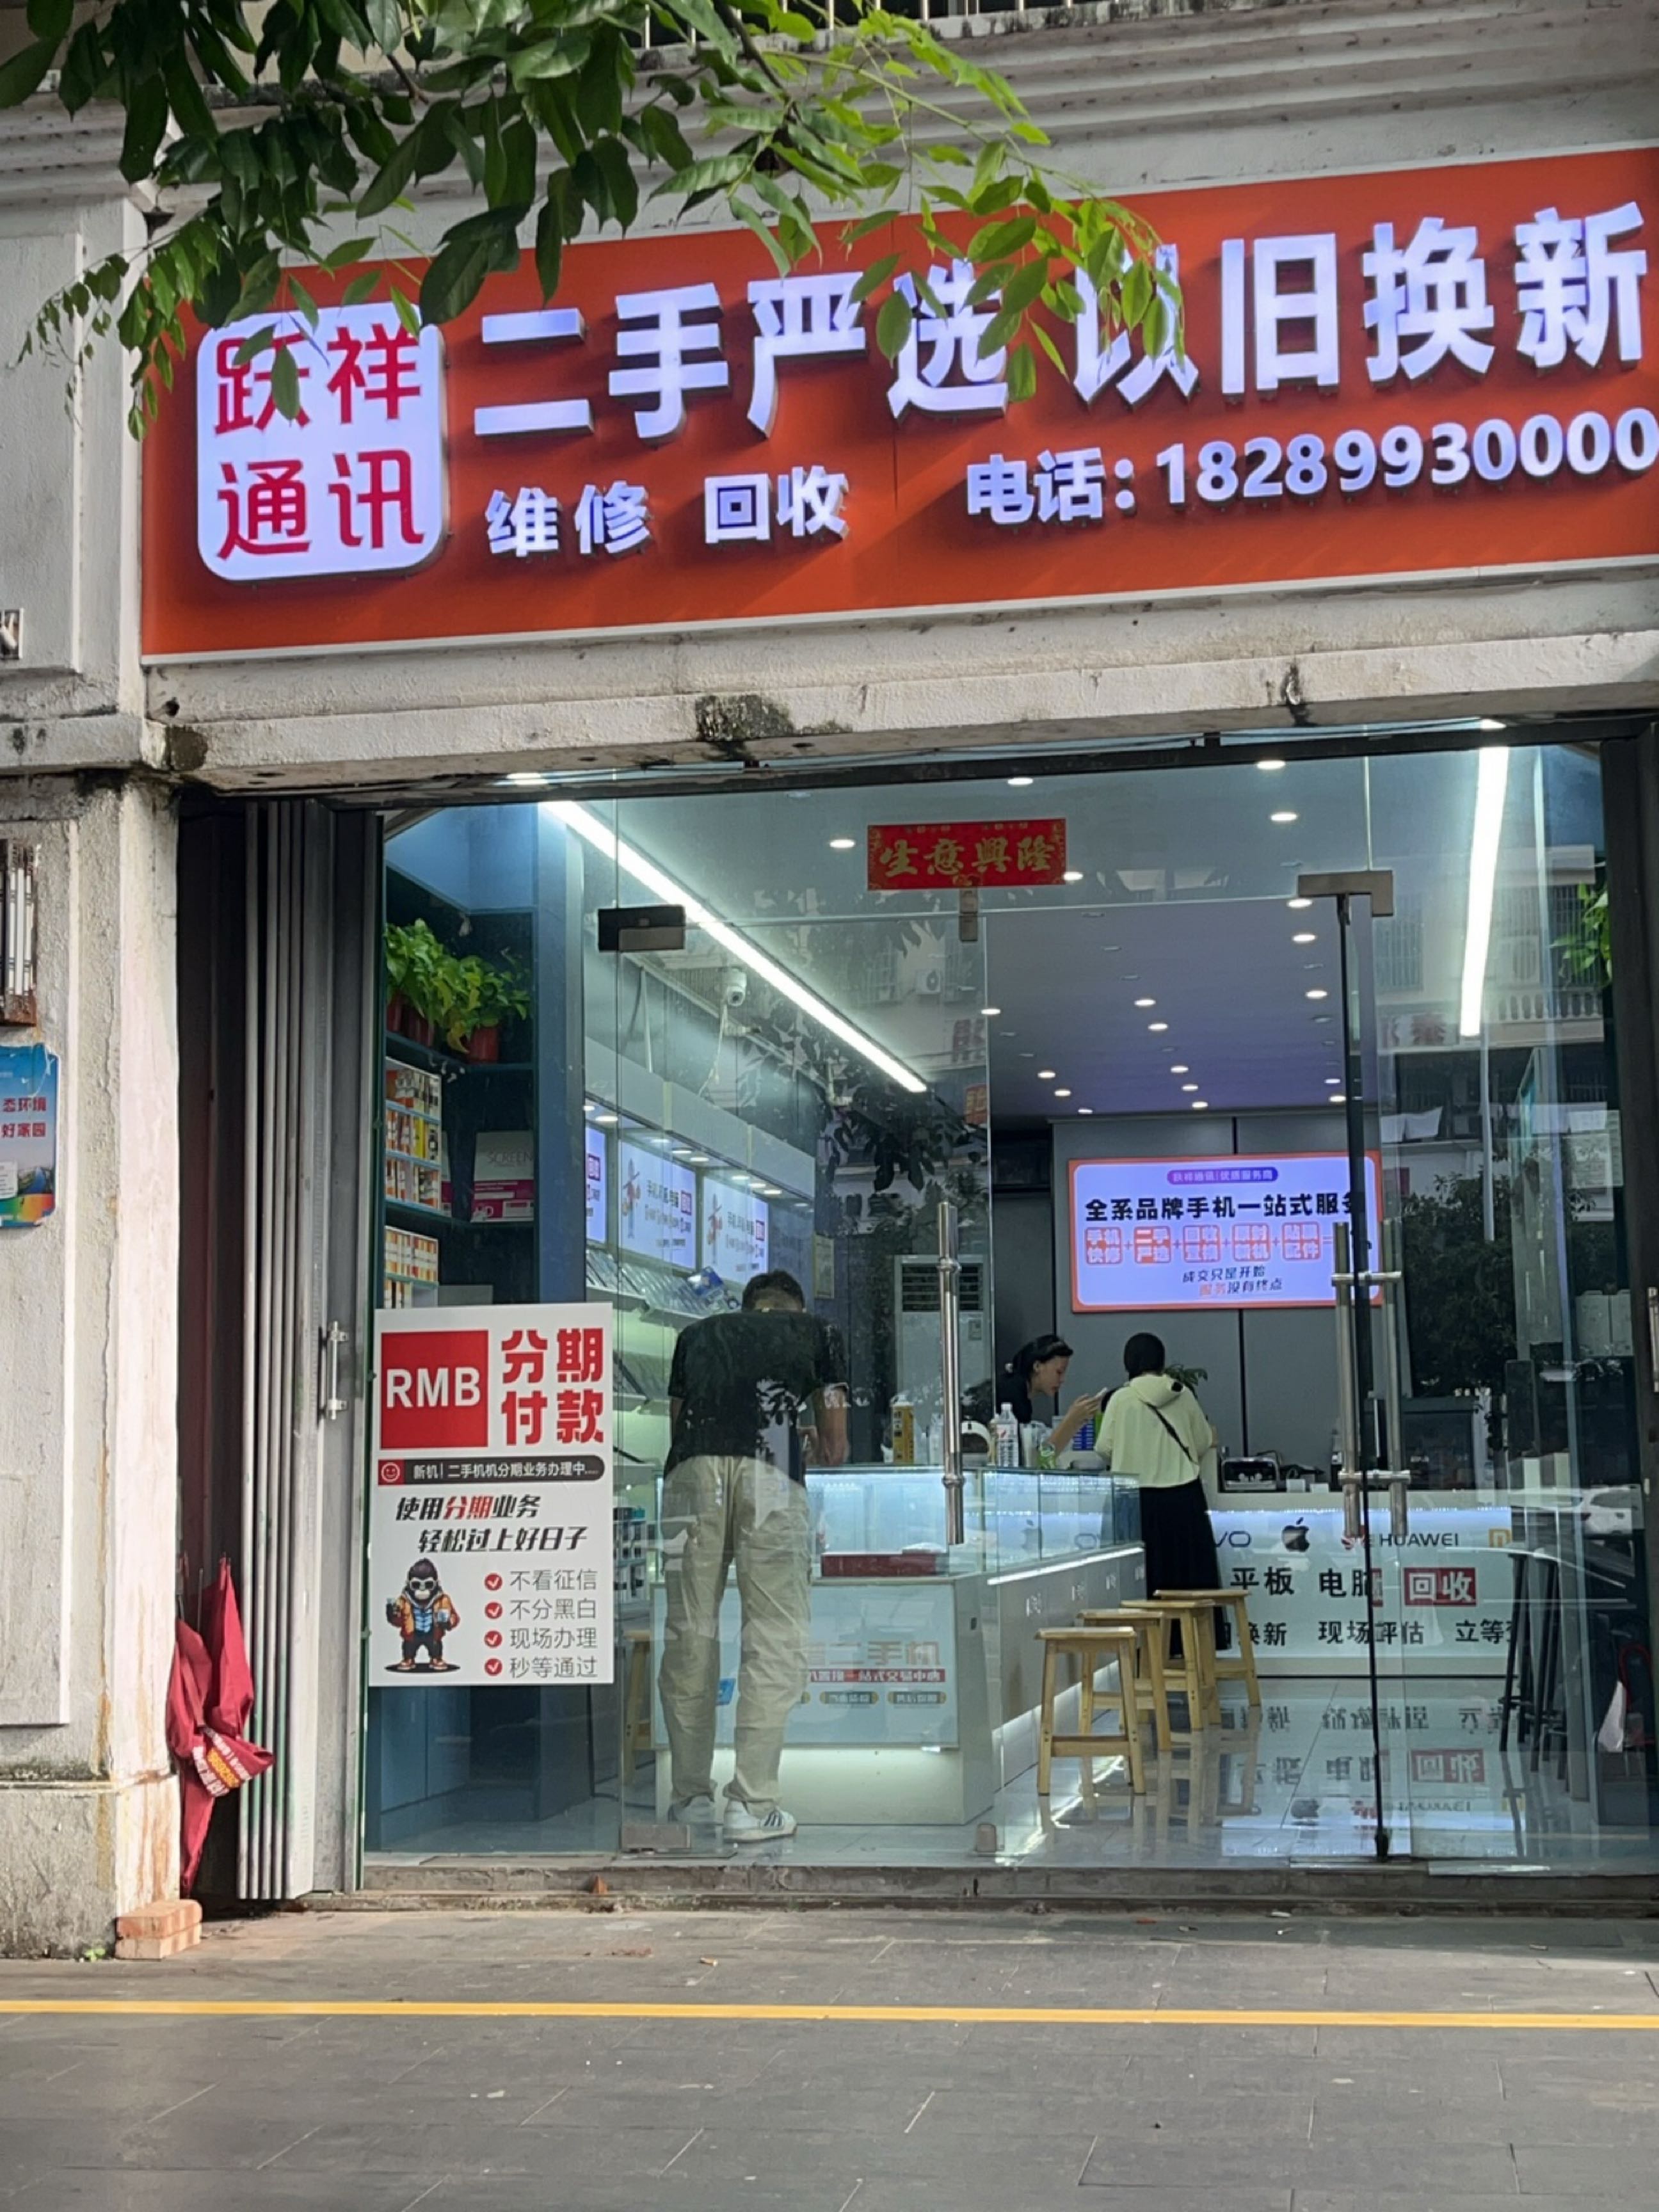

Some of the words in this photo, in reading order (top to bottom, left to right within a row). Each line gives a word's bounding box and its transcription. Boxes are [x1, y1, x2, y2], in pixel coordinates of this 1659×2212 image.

[474, 257, 1009, 442] 二手严选
[1074, 201, 1648, 406] 以旧换新
[214, 323, 422, 435] 跃祥
[216, 449, 425, 561] 通讯
[485, 480, 652, 556] 维修
[704, 465, 848, 544] 回收
[501, 1328, 604, 1383] 分期
[386, 1366, 481, 1408] RMB
[501, 1388, 604, 1446] 付款
[396, 1494, 541, 1521] 使用分期业务
[417, 1526, 588, 1553] 轻松过上好日子
[1380, 1532, 1459, 1548] HUAWEI
[509, 1569, 598, 1592] 不看征信
[1230, 1567, 1295, 1596] 平板
[1409, 1571, 1473, 1602] 回收
[509, 1598, 597, 1620] 不分黑白
[509, 1627, 598, 1649] 现场办理
[509, 1656, 598, 1678] 秒等通过
